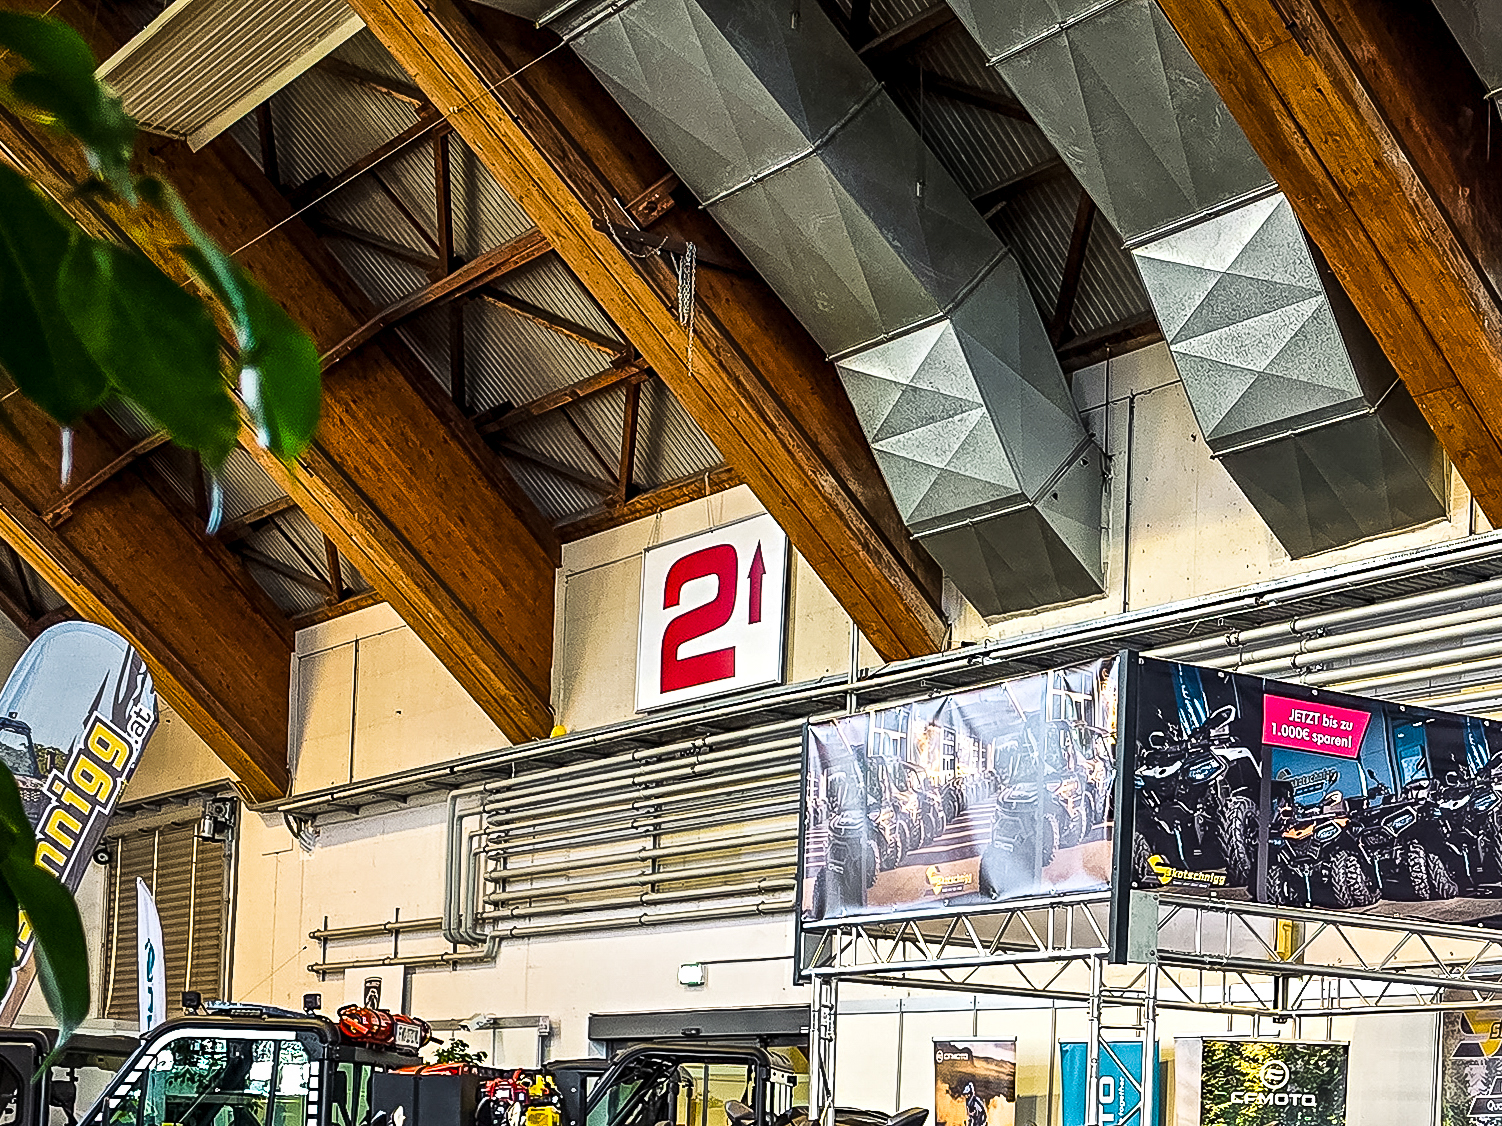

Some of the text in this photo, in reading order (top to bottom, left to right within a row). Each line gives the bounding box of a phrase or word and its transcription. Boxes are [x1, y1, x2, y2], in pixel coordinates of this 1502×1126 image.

[660, 543, 738, 694] 2
[1288, 708, 1353, 731] JETZT bis zu
[1271, 723, 1352, 749] 1.000€ sparen!
[1230, 1091, 1317, 1107] CFMOTO
